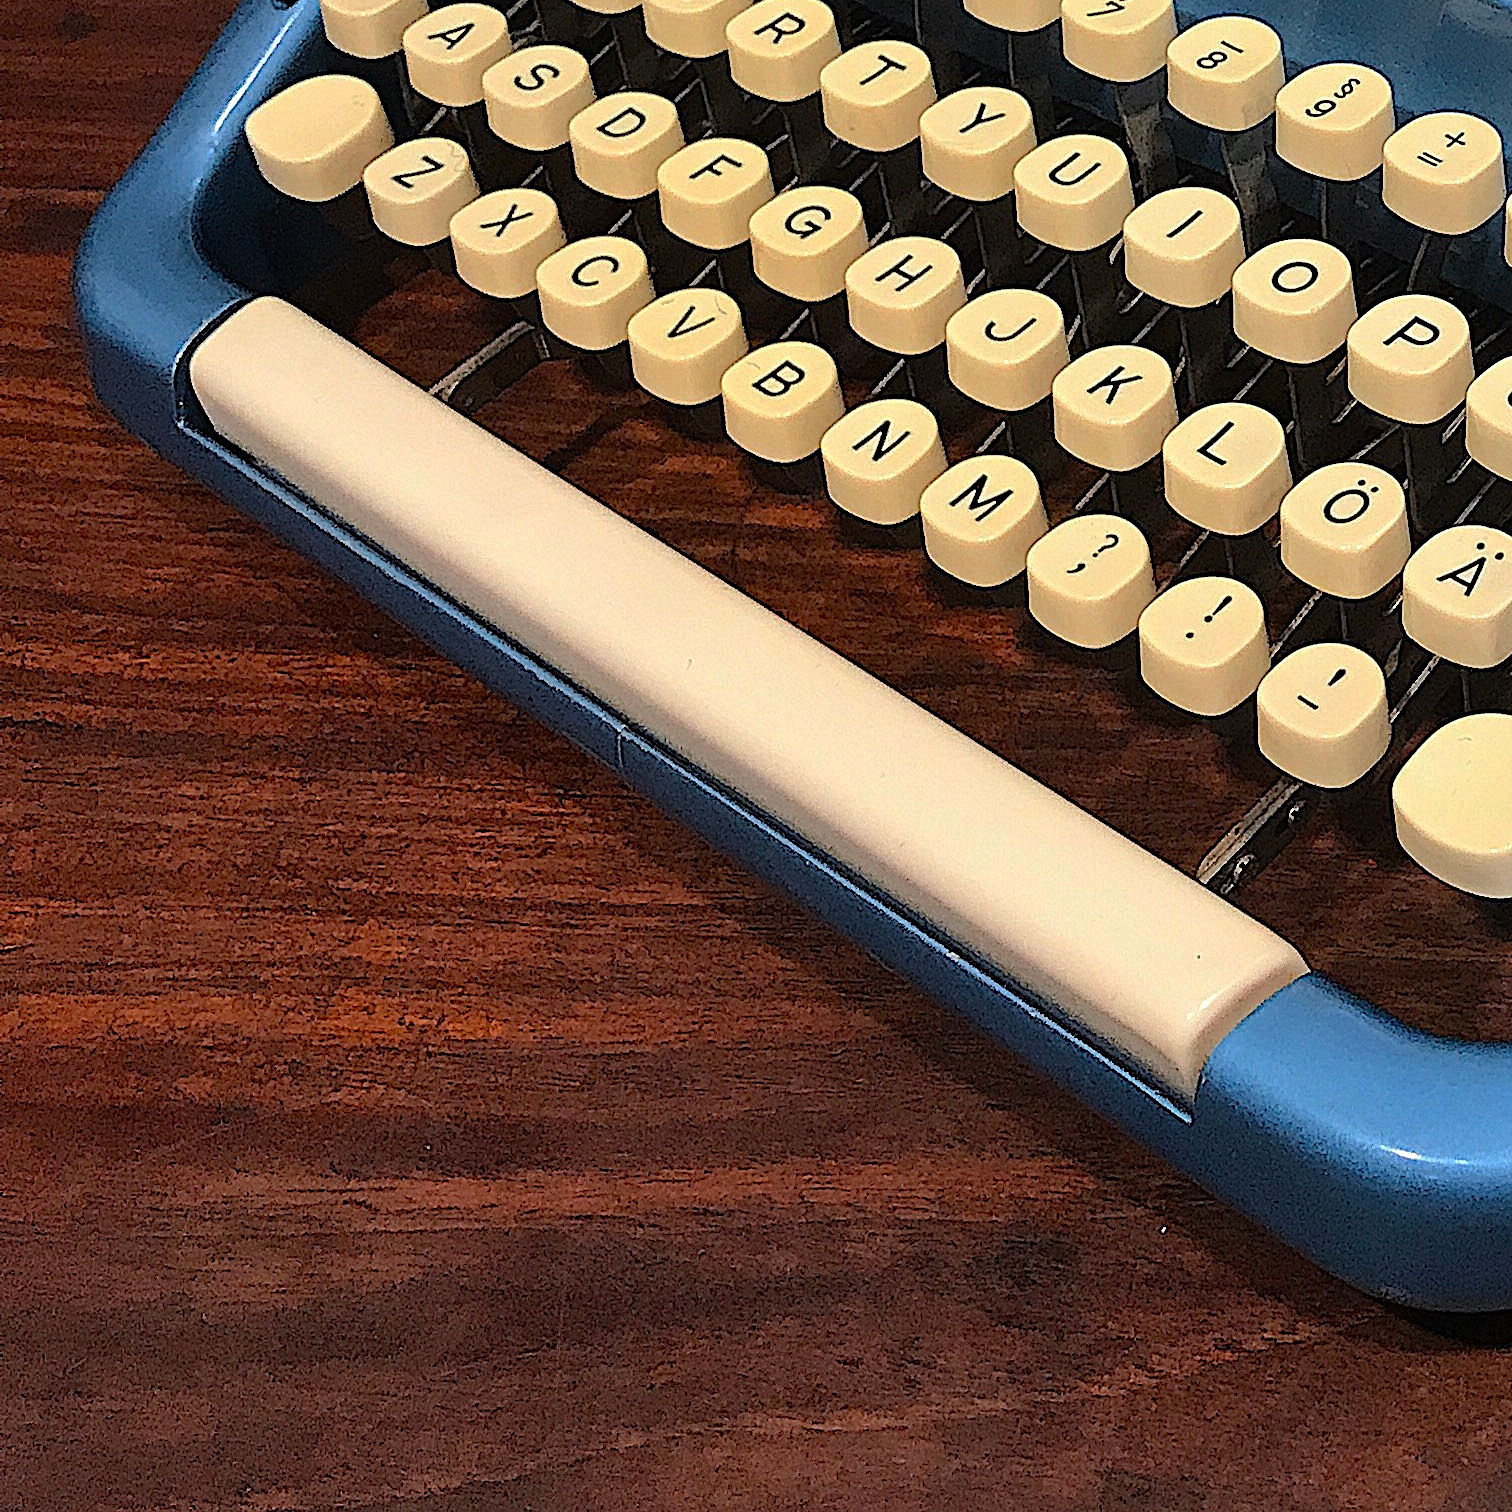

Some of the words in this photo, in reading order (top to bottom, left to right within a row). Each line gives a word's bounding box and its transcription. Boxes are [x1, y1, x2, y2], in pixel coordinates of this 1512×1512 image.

[427, 23, 476, 50] A
[753, 12, 806, 45] R
[513, 63, 560, 91] S
[859, 54, 907, 86] T
[1196, 51, 1228, 70] 8
[595, 106, 648, 139] D
[959, 102, 1006, 134] Y
[1305, 99, 1337, 118] 9
[390, 155, 445, 189] Z
[688, 154, 743, 180] F
[1048, 152, 1102, 186] U
[479, 204, 534, 238] X
[784, 205, 832, 240] G
[1166, 210, 1204, 238] I
[571, 255, 620, 287] C
[874, 254, 933, 292] H
[1271, 261, 1319, 294] O
[667, 305, 716, 338] V
[984, 317, 1037, 342] J
[1382, 315, 1440, 347] P
[751, 360, 806, 397] B
[1086, 365, 1143, 405] K
[851, 420, 911, 462] N
[1196, 421, 1235, 466] L
[948, 473, 1015, 523] M
[1323, 479, 1380, 524] Ö
[1436, 542, 1505, 597] Ä
